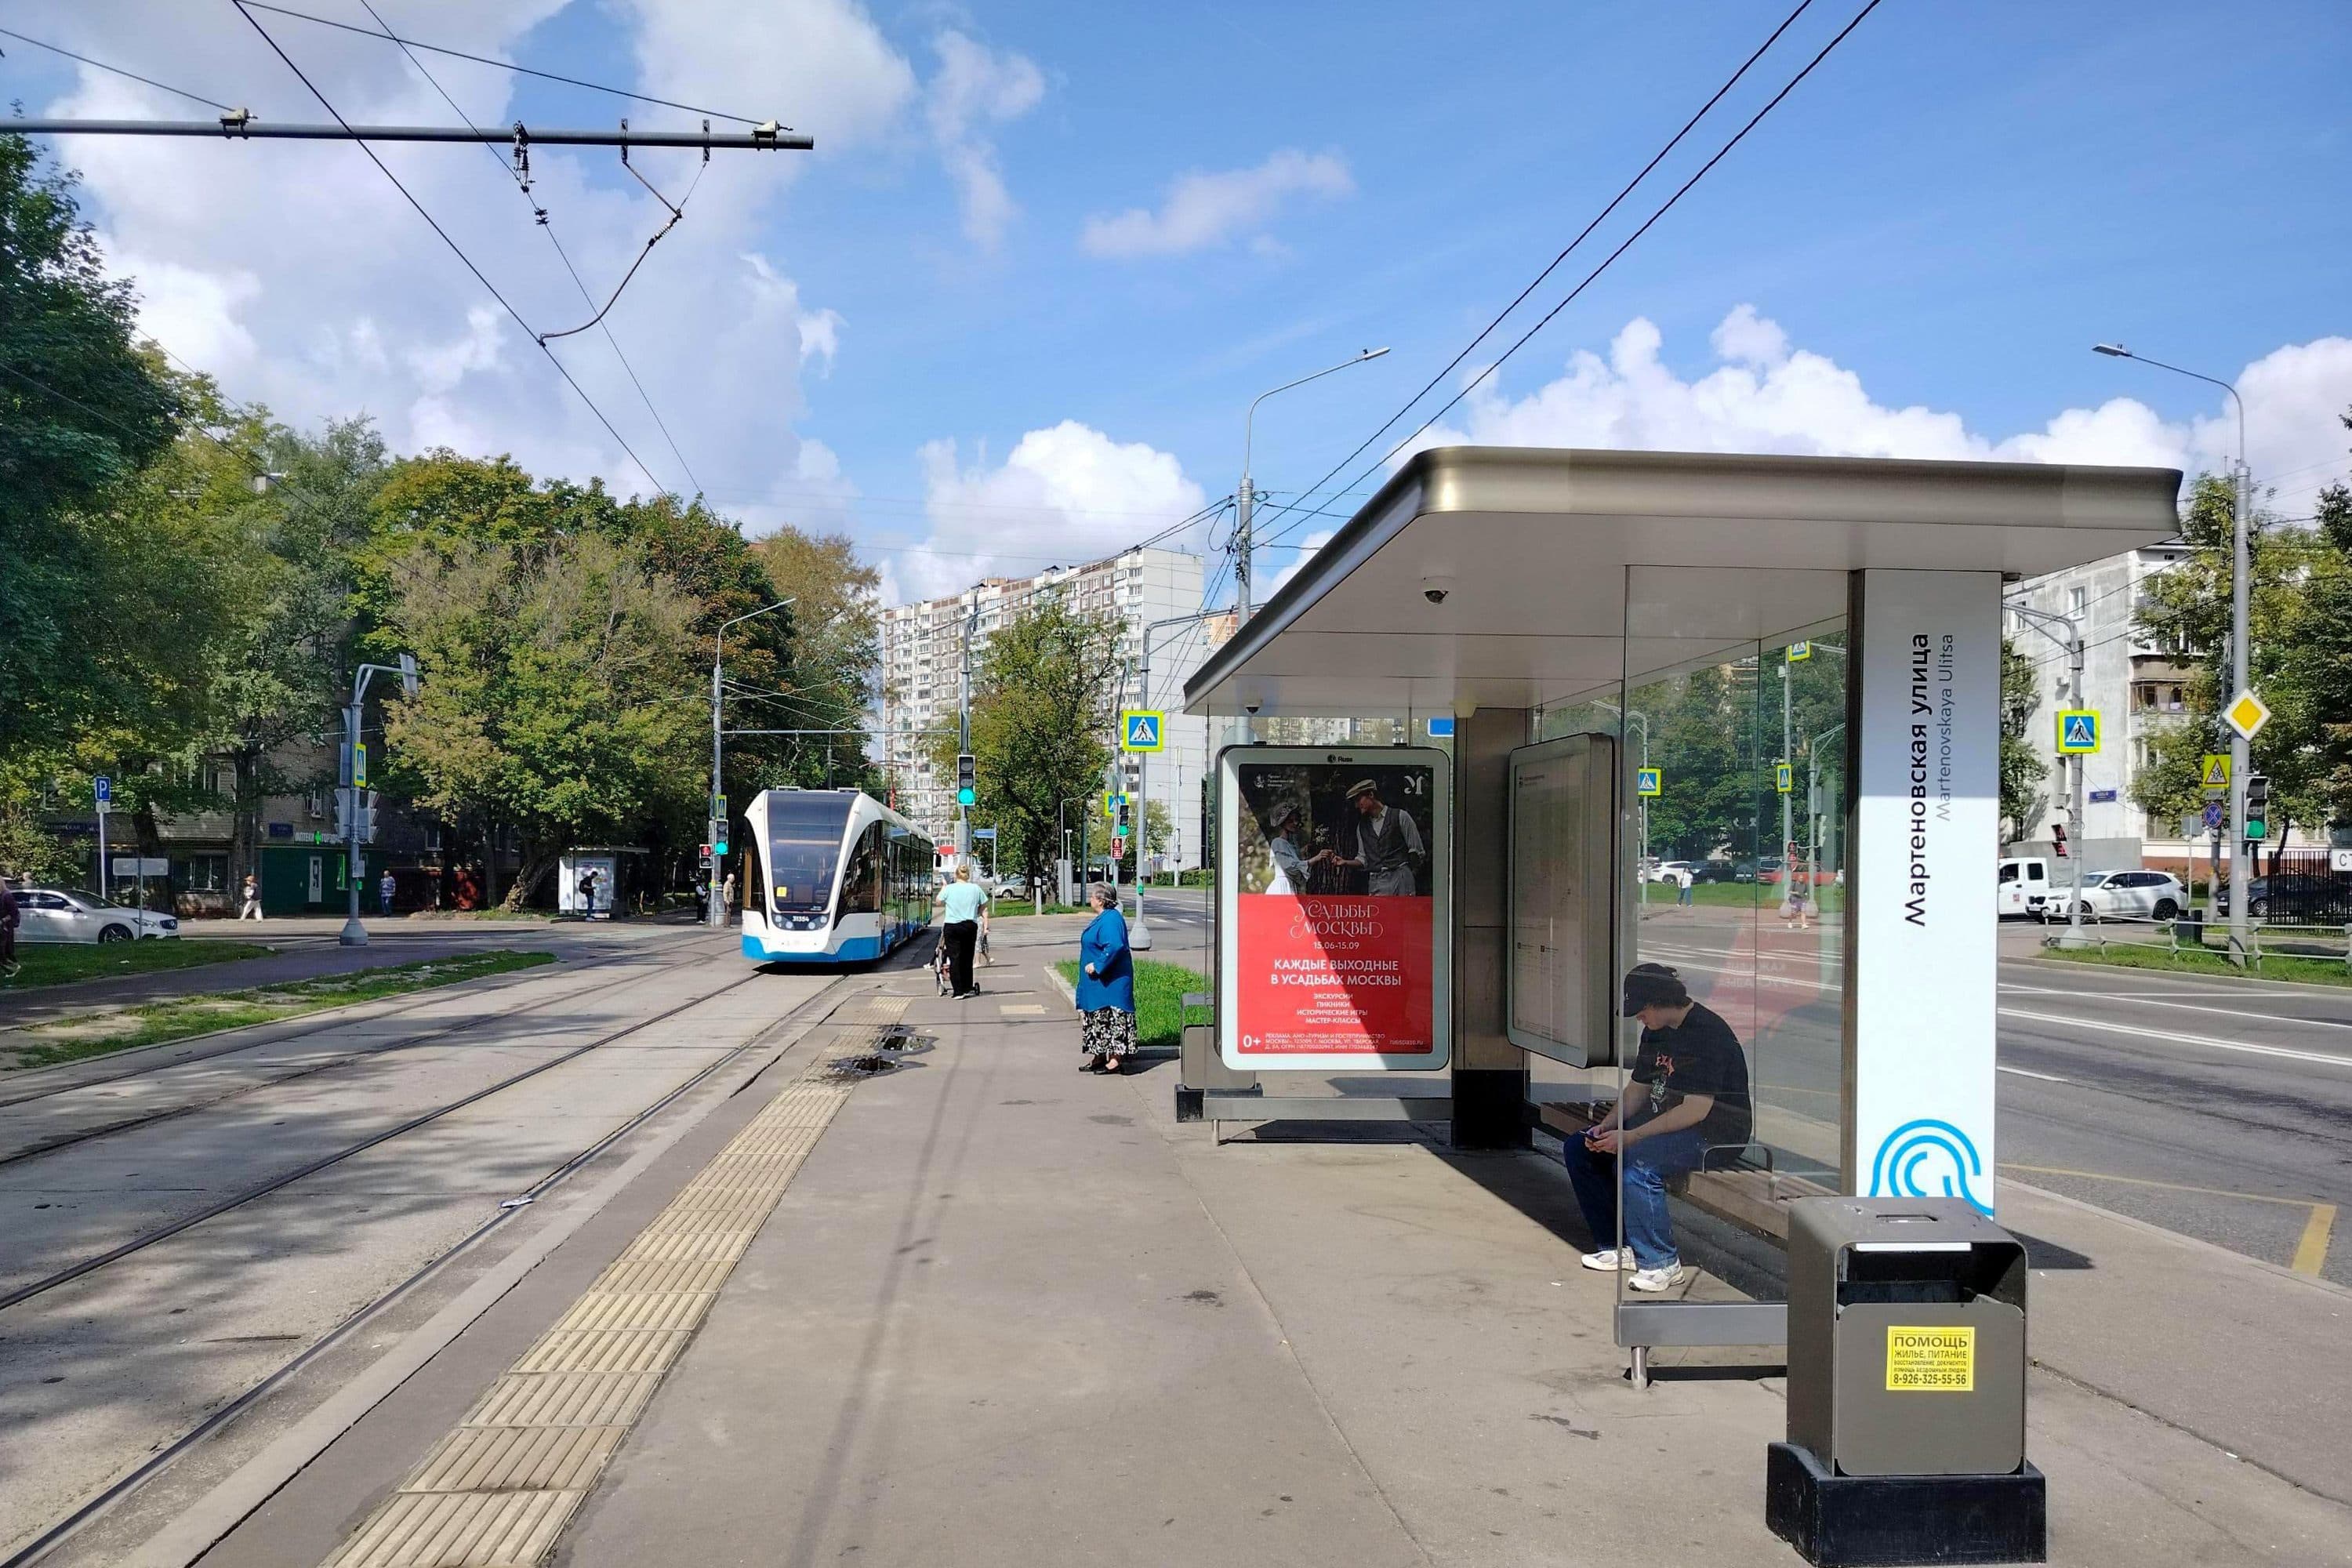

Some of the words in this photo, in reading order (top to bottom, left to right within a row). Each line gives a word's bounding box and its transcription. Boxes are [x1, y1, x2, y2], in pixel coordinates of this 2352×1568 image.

[1938, 634, 1953, 681] Ulitsa
[1912, 634, 1932, 715] улица
[1936, 689, 1955, 822] Martenovskaya
[100, 780, 107, 797] P
[1904, 724, 1930, 927] Мартеновская
[2339, 853, 2352, 867] С
[1294, 900, 1380, 922] УСАДЬБЫ
[1290, 921, 1384, 938] МОСКВЫ
[1274, 960, 1327, 971] КАЖДЫЕ
[1330, 960, 1399, 971] ВЫХОДНЫЕ
[1271, 975, 1279, 985] В
[1282, 975, 1344, 986] УСАДЬБАХ
[1347, 975, 1402, 985] МОСКВЫ
[1243, 1035, 1261, 1047] 0+
[1894, 1337, 1967, 1349] ПОМОЩЬ
[1894, 1350, 1926, 1359] ЖИЛЬЕ,
[1928, 1350, 1967, 1359] ПИТАНИЕ
[1893, 1374, 1966, 1385] 8-926-325-55-56
